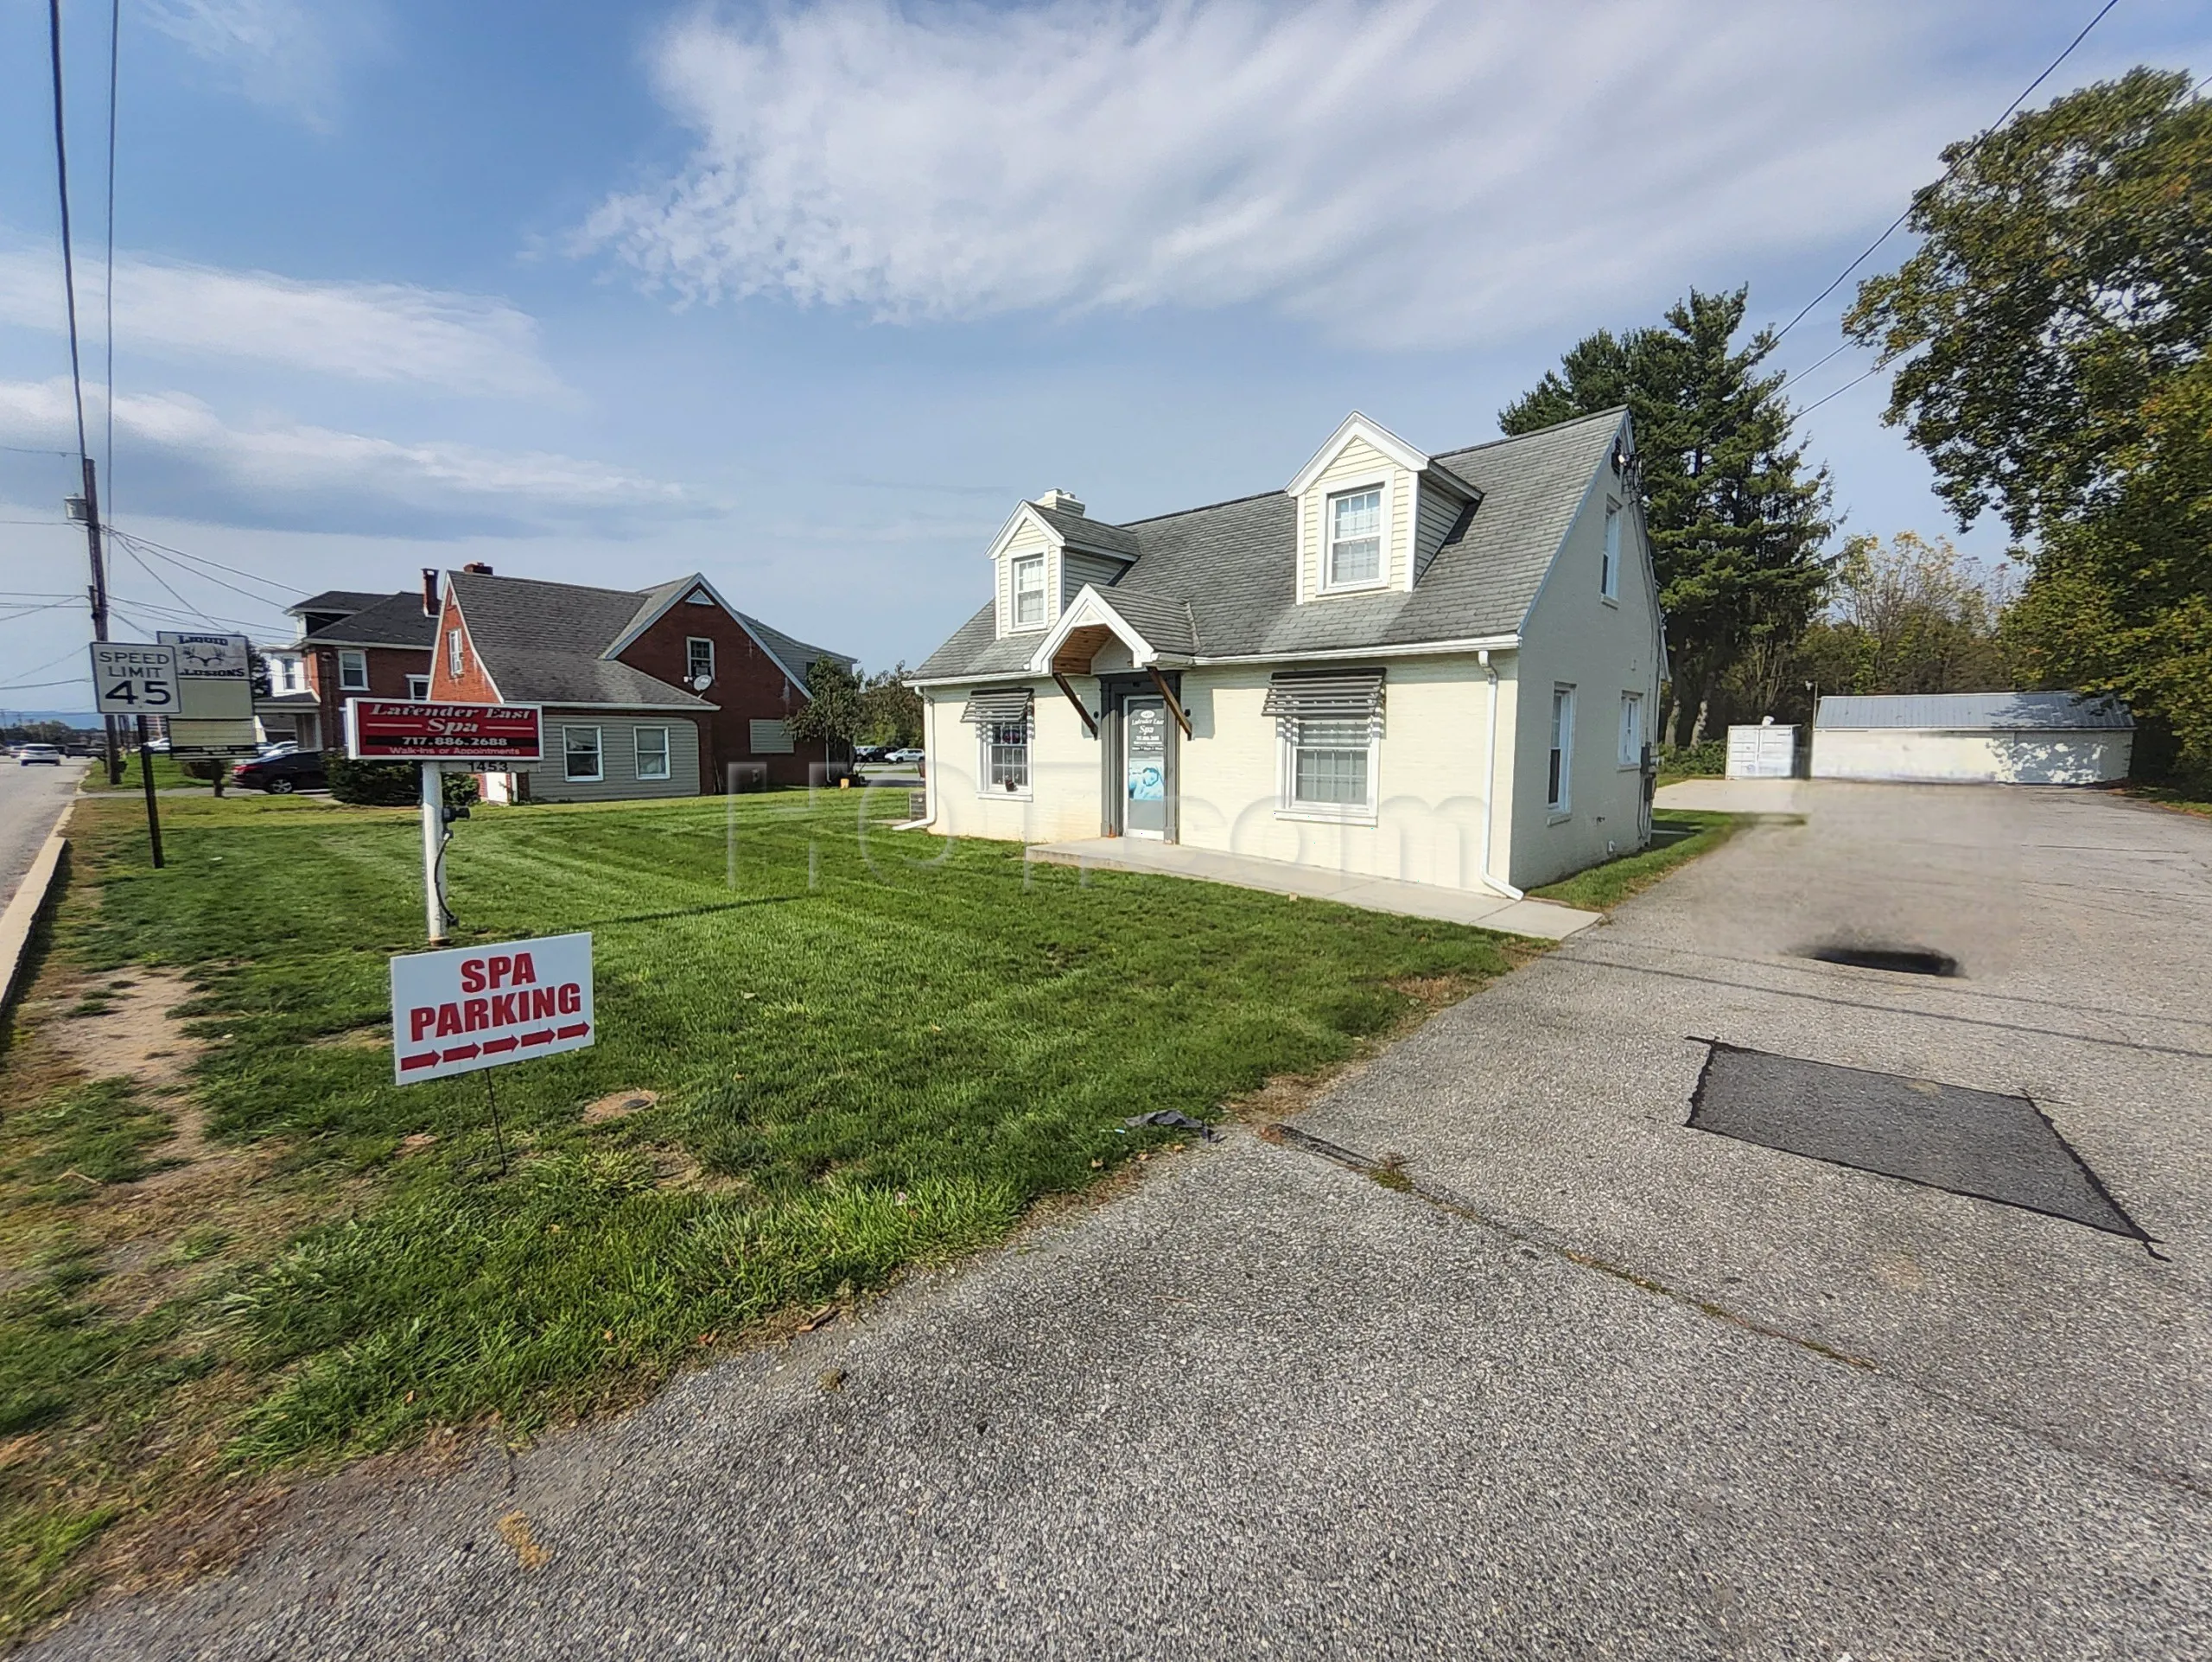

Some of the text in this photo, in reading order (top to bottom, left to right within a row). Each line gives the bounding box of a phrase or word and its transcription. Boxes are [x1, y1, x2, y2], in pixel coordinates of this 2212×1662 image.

[99, 651, 169, 665] SPEED
[108, 666, 163, 678] LIMIT
[178, 668, 245, 678] LUSIONS
[105, 679, 172, 705] 45
[368, 704, 531, 719] Lavender East
[426, 717, 479, 735] Spa
[1139, 725, 1154, 735] Spa
[402, 736, 508, 746] 717.886.2688
[453, 747, 520, 755] Appointments
[468, 761, 508, 772] 1453
[461, 952, 537, 994] SPA
[410, 982, 582, 1042] PARKING
